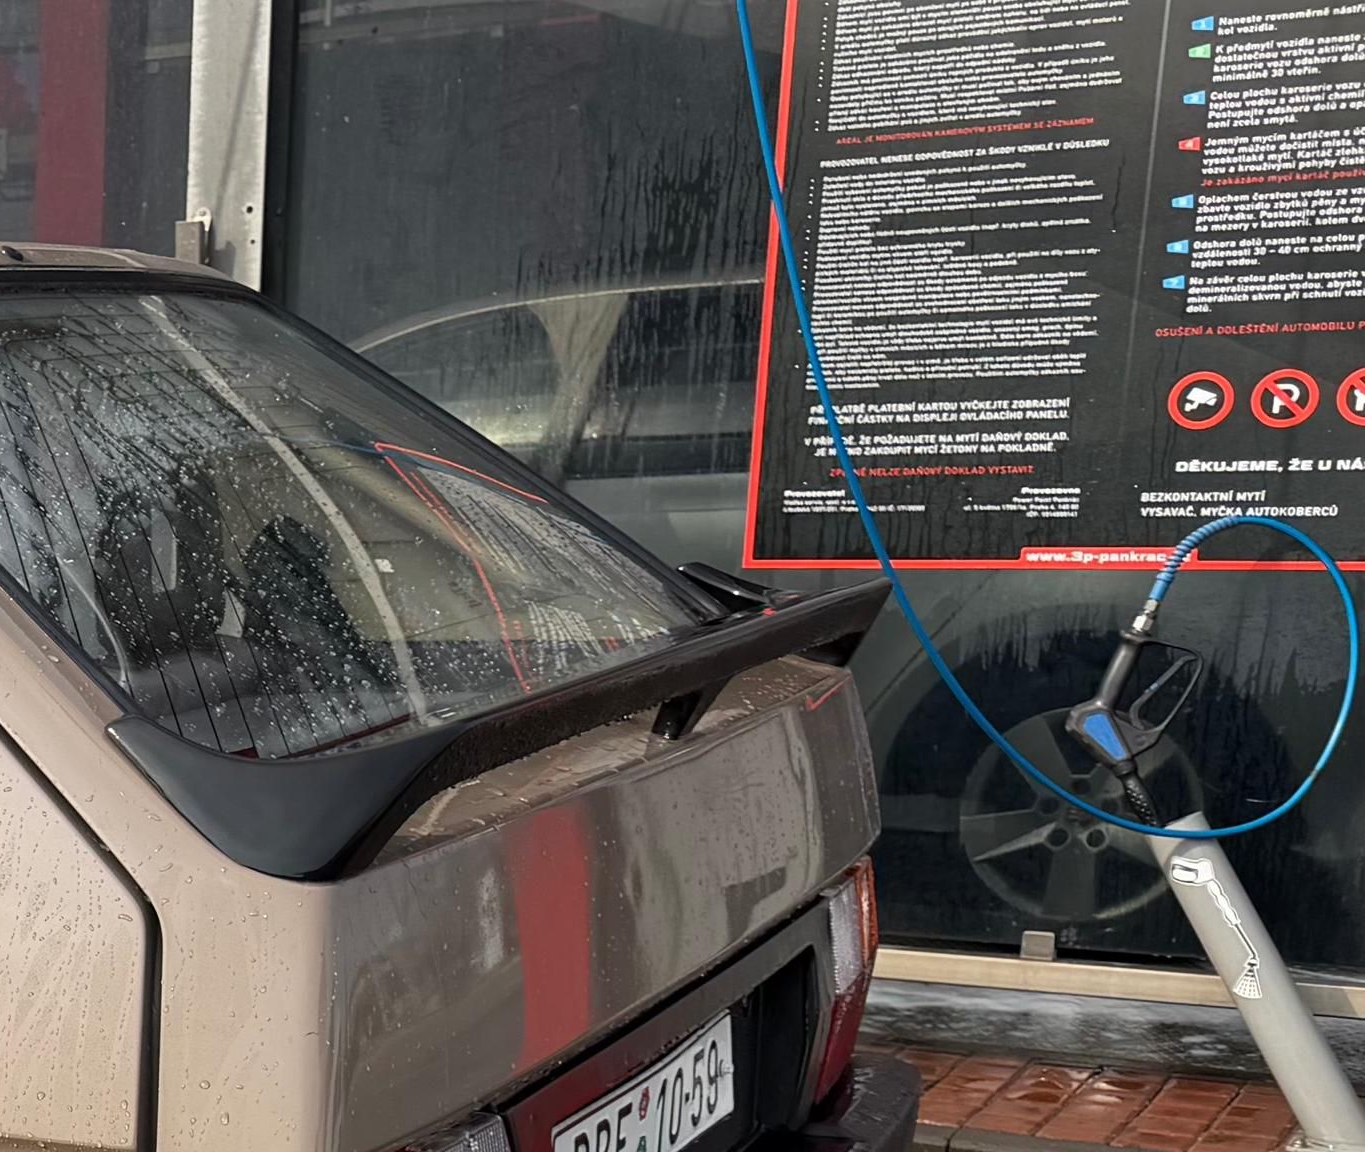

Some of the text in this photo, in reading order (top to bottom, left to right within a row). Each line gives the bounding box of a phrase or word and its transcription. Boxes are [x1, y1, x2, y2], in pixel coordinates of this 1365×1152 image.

[1219, 8, 1330, 26] Naneste rovnoměrně
[1217, 23, 1277, 36] kol vozidla.
[1227, 40, 1274, 55] předmytí
[1276, 38, 1315, 49] vozidla
[1317, 34, 1361, 44] naneste
[1214, 51, 1278, 64] dostatečnou
[1318, 43, 1355, 54] aktivní
[1213, 61, 1264, 73] karoserie
[1267, 59, 1292, 68] vozu
[1294, 55, 1338, 66] odshora
[1212, 66, 1321, 82] minimálně 30 vteřin.
[1210, 81, 1361, 102] Celou plochu karoserie vozu
[1208, 108, 1264, 120] Postupujte
[1267, 105, 1309, 115] odshora
[1313, 100, 1337, 111] dolů
[1209, 100, 1242, 111] teplou
[1245, 98, 1276, 108] vodou
[1288, 94, 1325, 104] aktivní
[1207, 119, 1230, 129] není
[1233, 118, 1260, 127] zcela
[1205, 128, 1340, 147] Jemným mycím kartáčem
[1204, 147, 1235, 156] vodou
[1237, 143, 1276, 154] můžete
[1279, 140, 1319, 151] dočistit
[1203, 155, 1264, 167] vysokotlaké
[1297, 147, 1333, 158] Kartáč
[1201, 158, 1336, 175] vozu krouživými pohyby
[1198, 193, 1250, 206] Oplachem
[1252, 190, 1298, 201] čerstvou
[1300, 188, 1333, 198] vodou
[1335, 187, 1348, 196] ze
[1197, 204, 1230, 214] zbavte
[1233, 201, 1271, 211] vozidlo
[1273, 197, 1309, 210] zbytků
[1311, 197, 1338, 209] pěny
[1196, 205, 1363, 224] prostředku. Postupujte odshora
[1195, 224, 1208, 232] na
[1211, 222, 1249, 232] mezery
[1193, 233, 1356, 250] Odshora dolů naneste na celou
[1192, 247, 1251, 260] vzdálenosti
[1253, 247, 1266, 256] 30
[1293, 245, 1309, 254] cm
[1191, 256, 1260, 269] teplou vodou.
[1189, 269, 1358, 286] Na závěr celou plochu karoserie
[1187, 287, 1342, 304] minerálních skvrn při schnutí
[1188, 282, 1286, 295] demineralizovanou
[1327, 279, 1362, 292] abyste
[1186, 304, 1212, 314] dolů.
[1155, 324, 1203, 337] OSUŠENÍ
[1206, 326, 1214, 335] A
[1217, 322, 1279, 335] DOLEŠTĚNÍ
[1281, 322, 1355, 333] AUTOMOBILU
[1175, 459, 1283, 473] DĚKUJEME,
[1287, 458, 1313, 472] ŽE
[1318, 459, 1332, 471] U
[1140, 490, 1266, 503] BEZKONTAKTNÍ MYTÍ
[1200, 505, 1243, 517] MYČKA
[1246, 504, 1339, 517] AUTOKOBERCŮ
